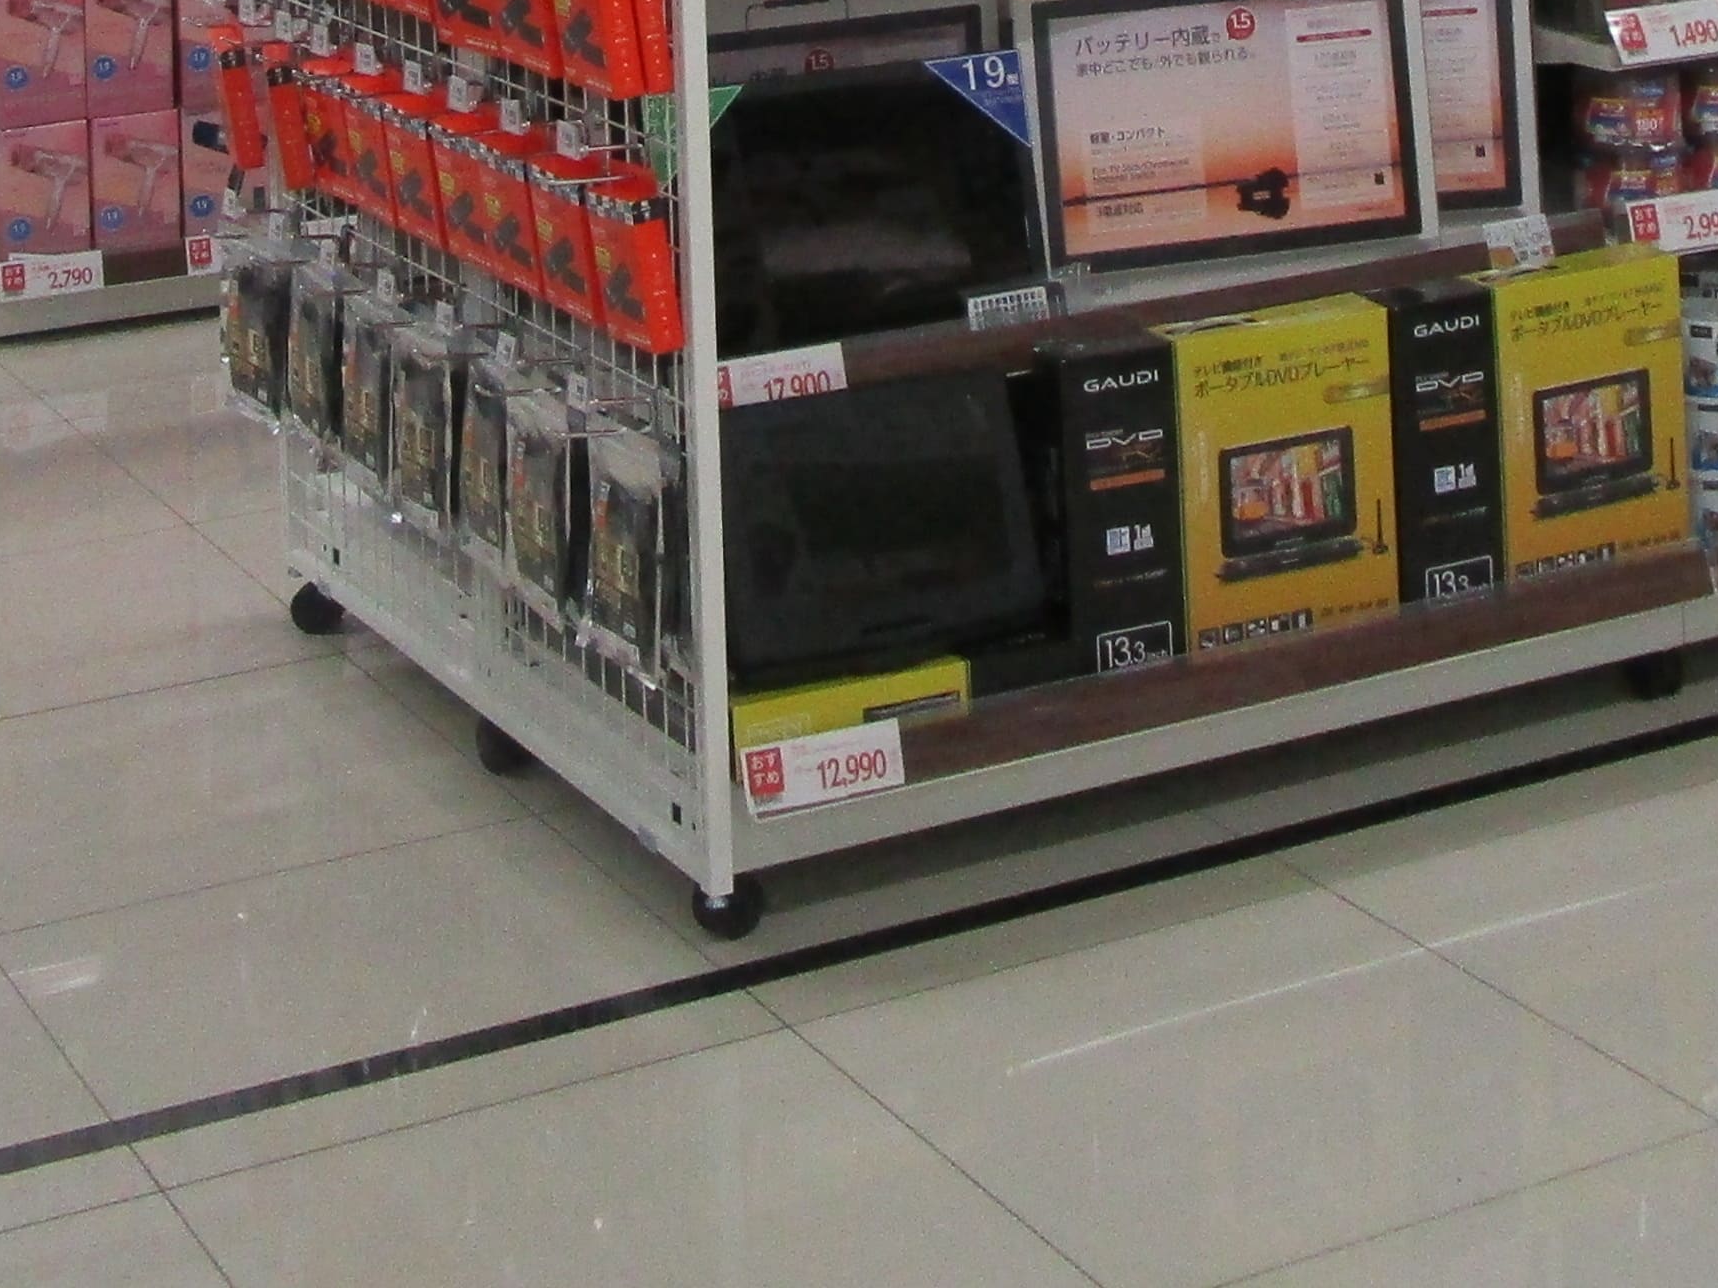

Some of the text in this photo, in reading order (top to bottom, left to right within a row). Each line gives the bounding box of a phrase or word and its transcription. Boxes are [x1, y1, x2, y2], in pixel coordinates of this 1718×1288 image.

[1669, 20, 1718, 48] 1,490
[48, 267, 94, 290] 2,790
[1414, 315, 1480, 338] GAUDI
[1083, 369, 1160, 393] GAUDI
[817, 749, 887, 790] 12,990
